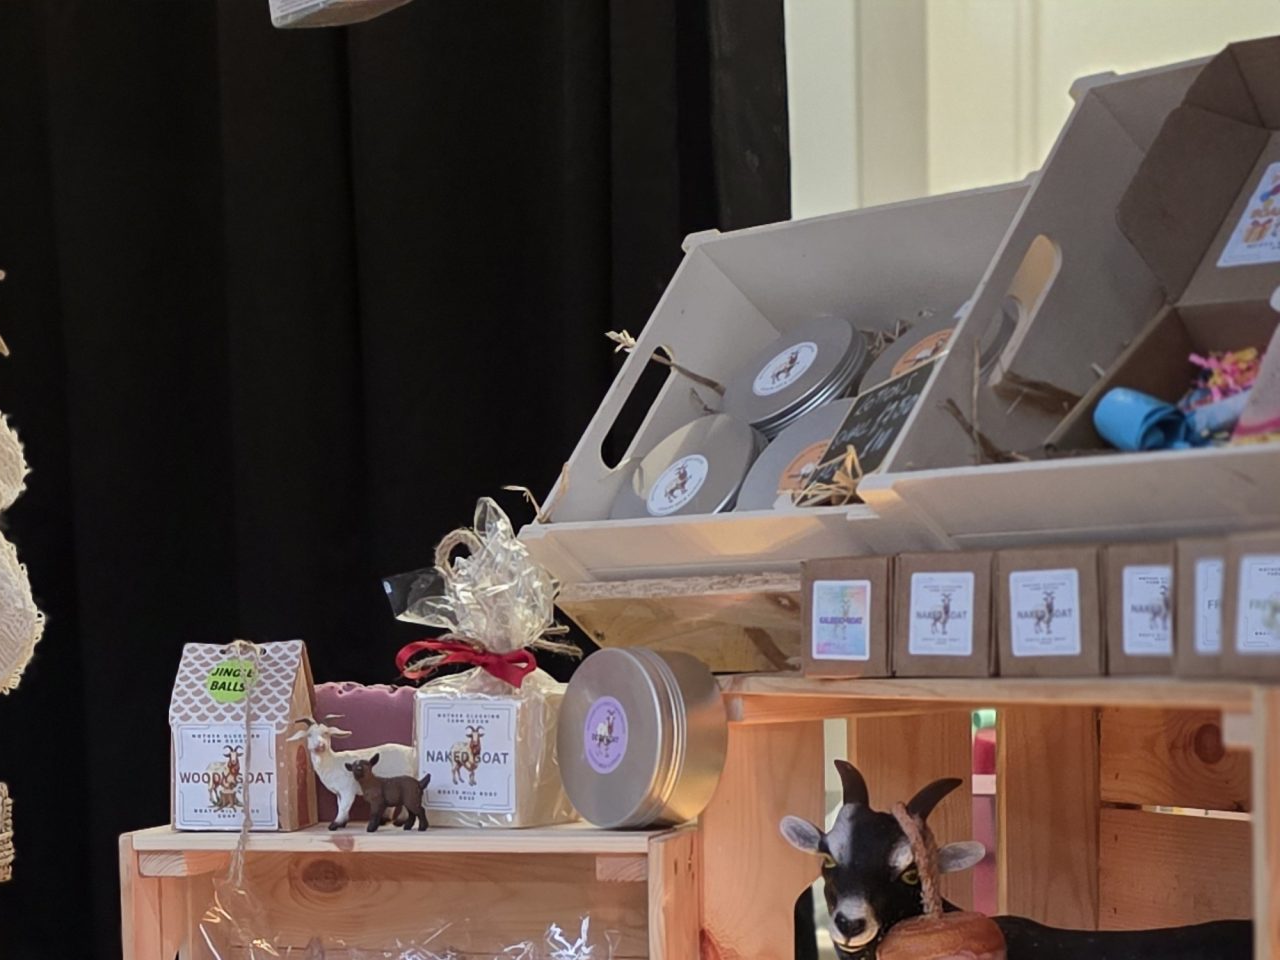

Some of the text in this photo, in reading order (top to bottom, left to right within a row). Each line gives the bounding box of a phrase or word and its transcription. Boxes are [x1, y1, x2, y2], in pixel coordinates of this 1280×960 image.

[211, 667, 254, 677] JINGE
[210, 681, 246, 692] BALLS
[426, 750, 509, 764] NAKED GOAT
[180, 772, 229, 784] WOODY
